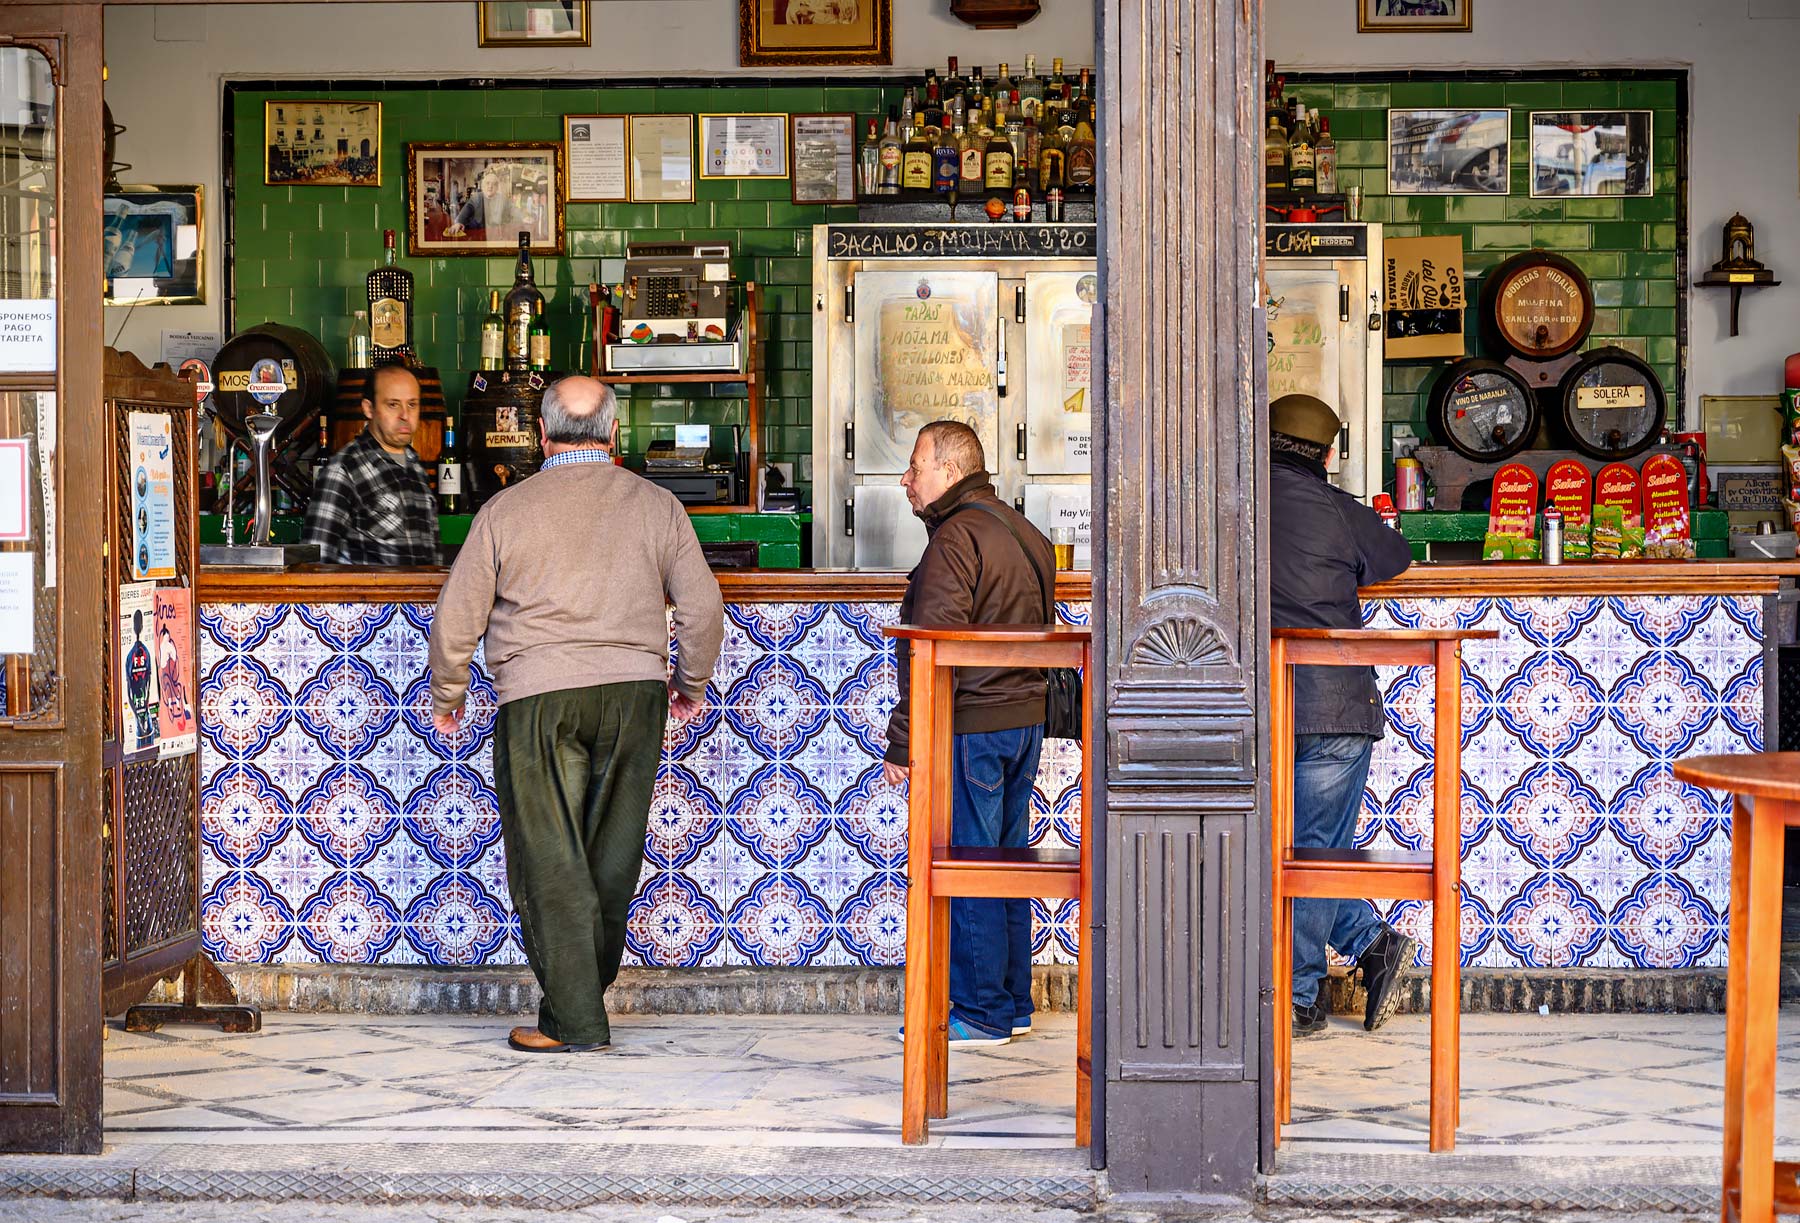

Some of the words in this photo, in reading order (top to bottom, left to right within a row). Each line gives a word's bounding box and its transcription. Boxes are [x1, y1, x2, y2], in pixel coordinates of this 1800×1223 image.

[832, 231, 918, 257] BACALAO
[940, 230, 1031, 255] MOJAMA
[1276, 229, 1312, 254] CASA
[1421, 259, 1436, 283] del
[1388, 258, 1397, 300] PATATAS
[1504, 270, 1540, 299] BODEGAS
[1546, 269, 1578, 298] HIDALGO
[1446, 267, 1461, 308] CORTI
[904, 301, 942, 321] TAPAS
[4, 324, 32, 332] PAGO
[891, 328, 950, 345] MOJAMA
[1268, 354, 1296, 373] PAS
[249, 383, 284, 392] Cruzcampo
[1593, 388, 1630, 399] SOLERA
[1455, 396, 1470, 406] VINO
[1470, 394, 1479, 403] DE
[1479, 388, 1508, 401] NARANJA
[488, 434, 526, 444] VERMUT
[1551, 478, 1582, 490] Salen
[1647, 473, 1677, 487] Salen
[1498, 481, 1528, 493] Salen
[1601, 481, 1632, 494] Salen
[1651, 489, 1679, 499] Almendras
[1500, 497, 1528, 505] Almendras
[1060, 509, 1078, 519] Hay
[1075, 536, 1090, 544] nco
